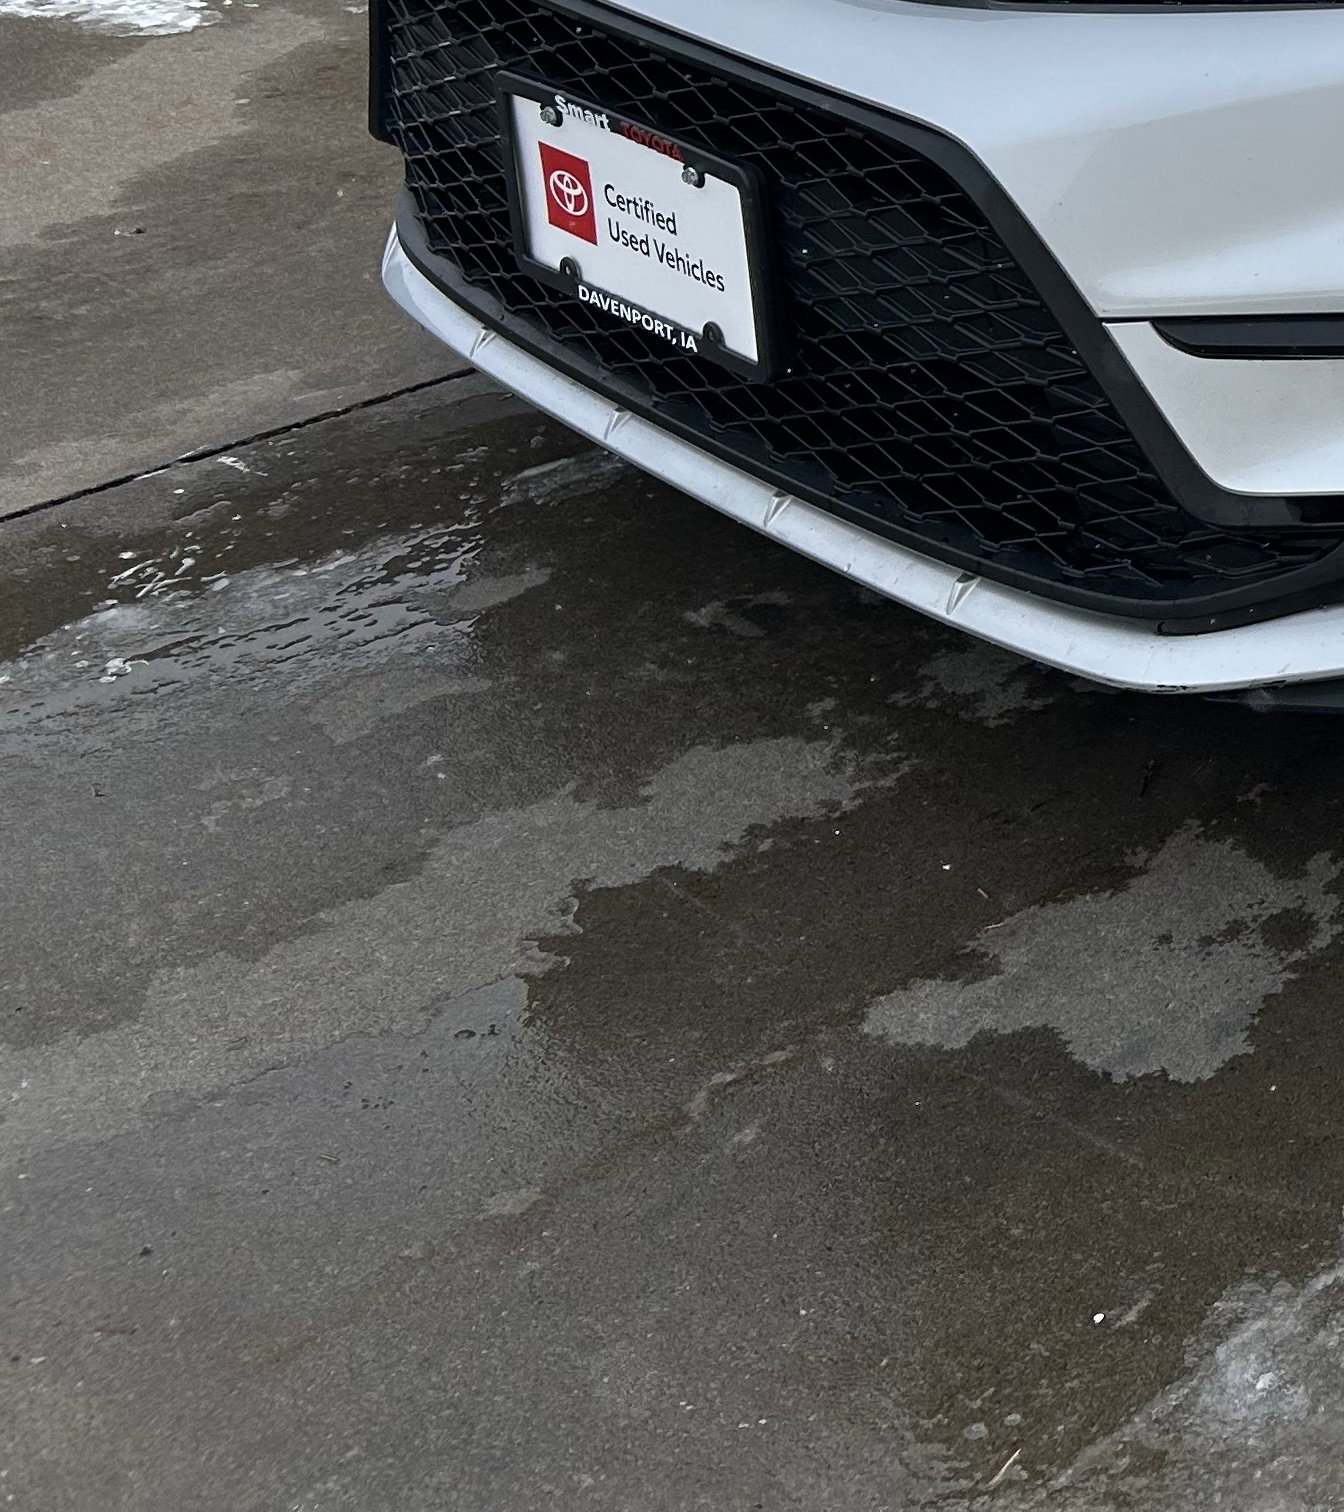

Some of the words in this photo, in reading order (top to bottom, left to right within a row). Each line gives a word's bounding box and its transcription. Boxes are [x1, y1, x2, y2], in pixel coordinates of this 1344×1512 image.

[554, 95, 612, 132] Smart
[620, 120, 683, 161] TOYOTA
[604, 183, 677, 236] Certified
[607, 218, 650, 257] Used
[653, 238, 725, 292] Vehicles
[578, 285, 677, 345] DAVENPORT,
[681, 331, 698, 353] IA
